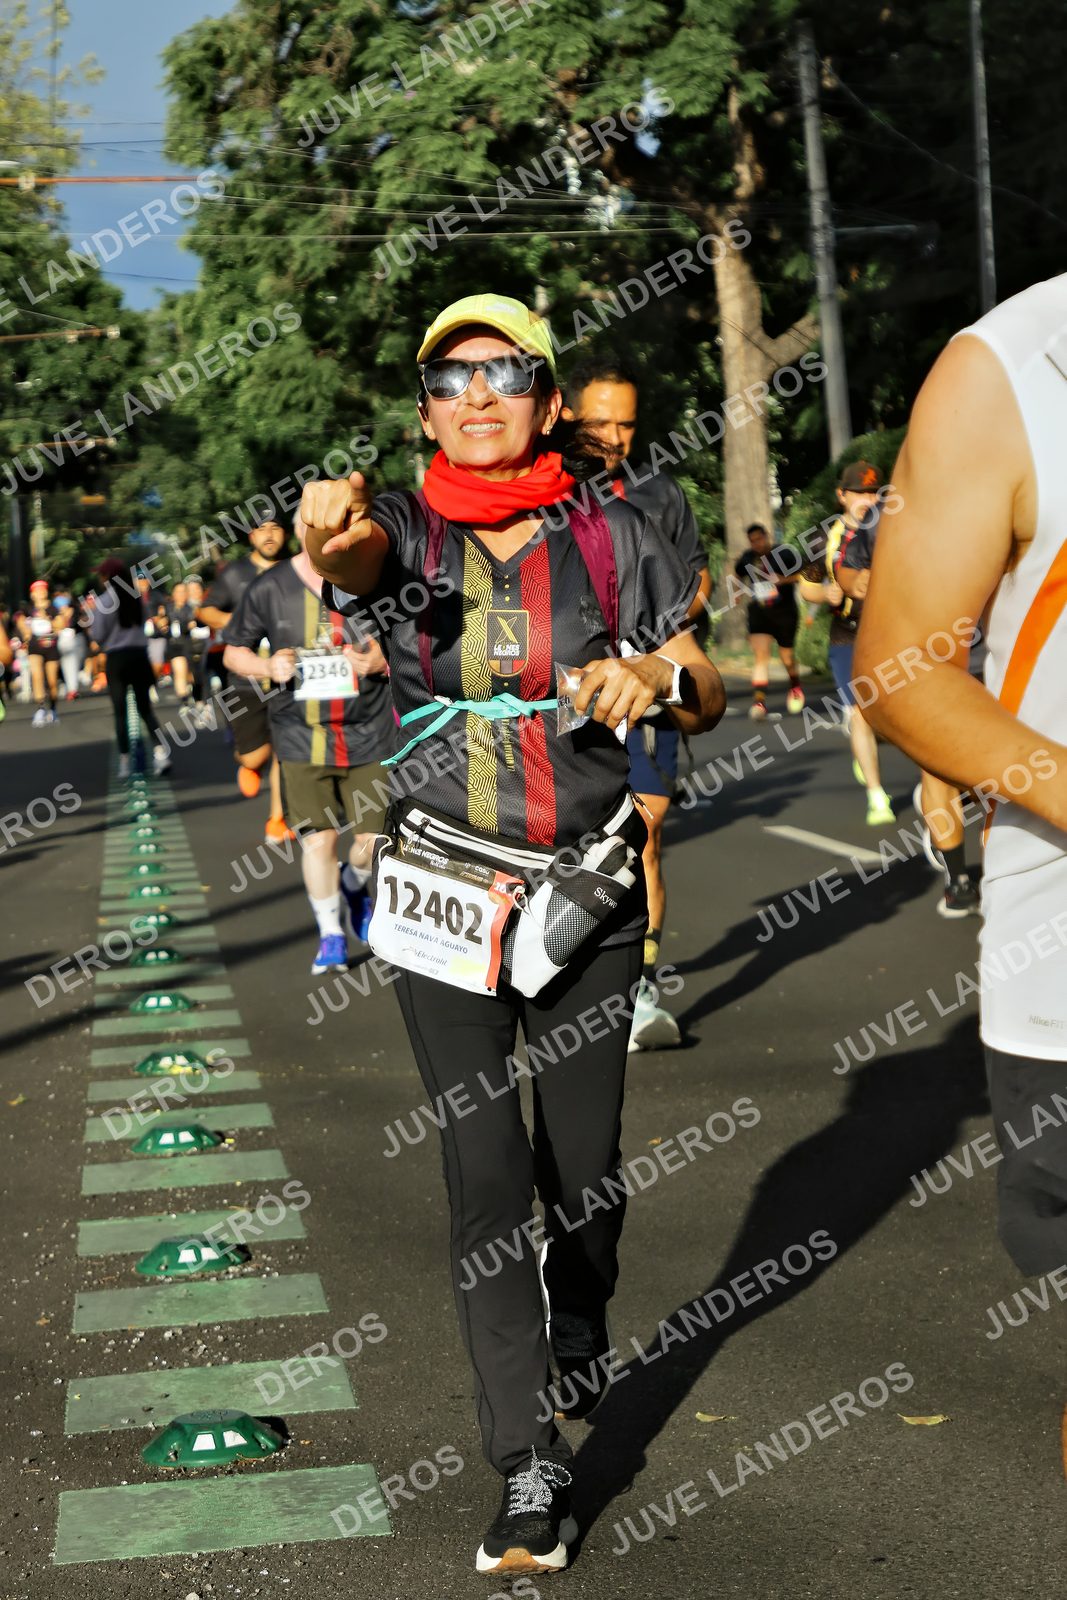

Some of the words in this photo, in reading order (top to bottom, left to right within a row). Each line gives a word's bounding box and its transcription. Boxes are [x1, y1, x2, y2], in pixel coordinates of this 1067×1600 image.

[384, 875, 483, 945] 12402
[394, 923, 418, 937] TERESA
[418, 932, 439, 944] NAVA
[440, 939, 469, 954] AGUAYO
